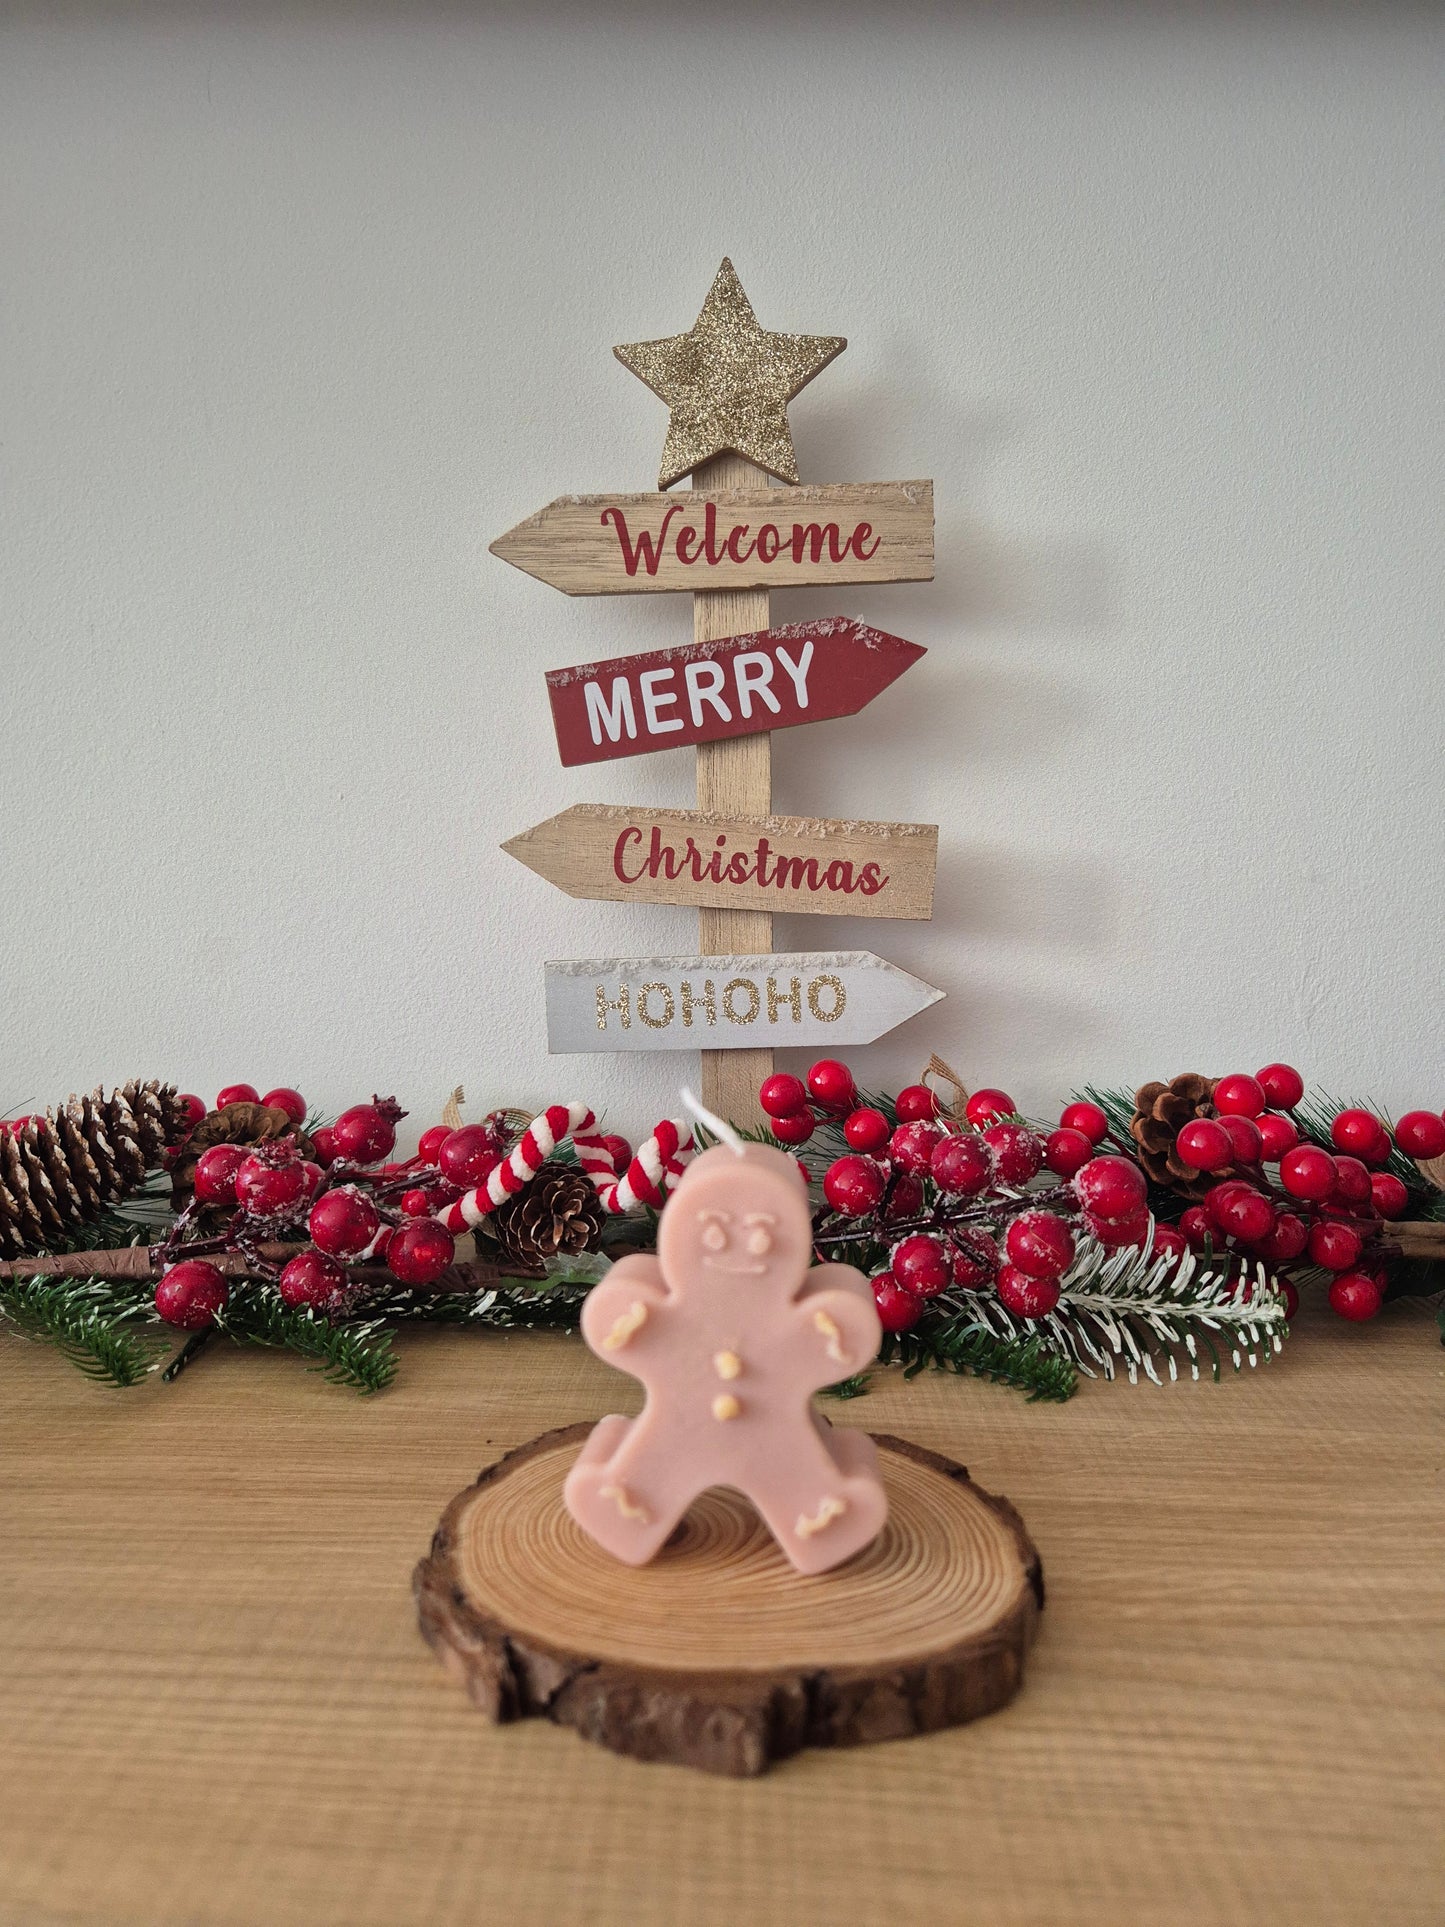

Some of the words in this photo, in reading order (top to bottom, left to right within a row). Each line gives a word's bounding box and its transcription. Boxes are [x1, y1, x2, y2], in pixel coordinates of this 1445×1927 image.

[601, 502, 881, 577] Welcome
[583, 641, 815, 746] MERRY
[614, 826, 889, 896] Christmas
[596, 974, 847, 1030] HOHOHO
